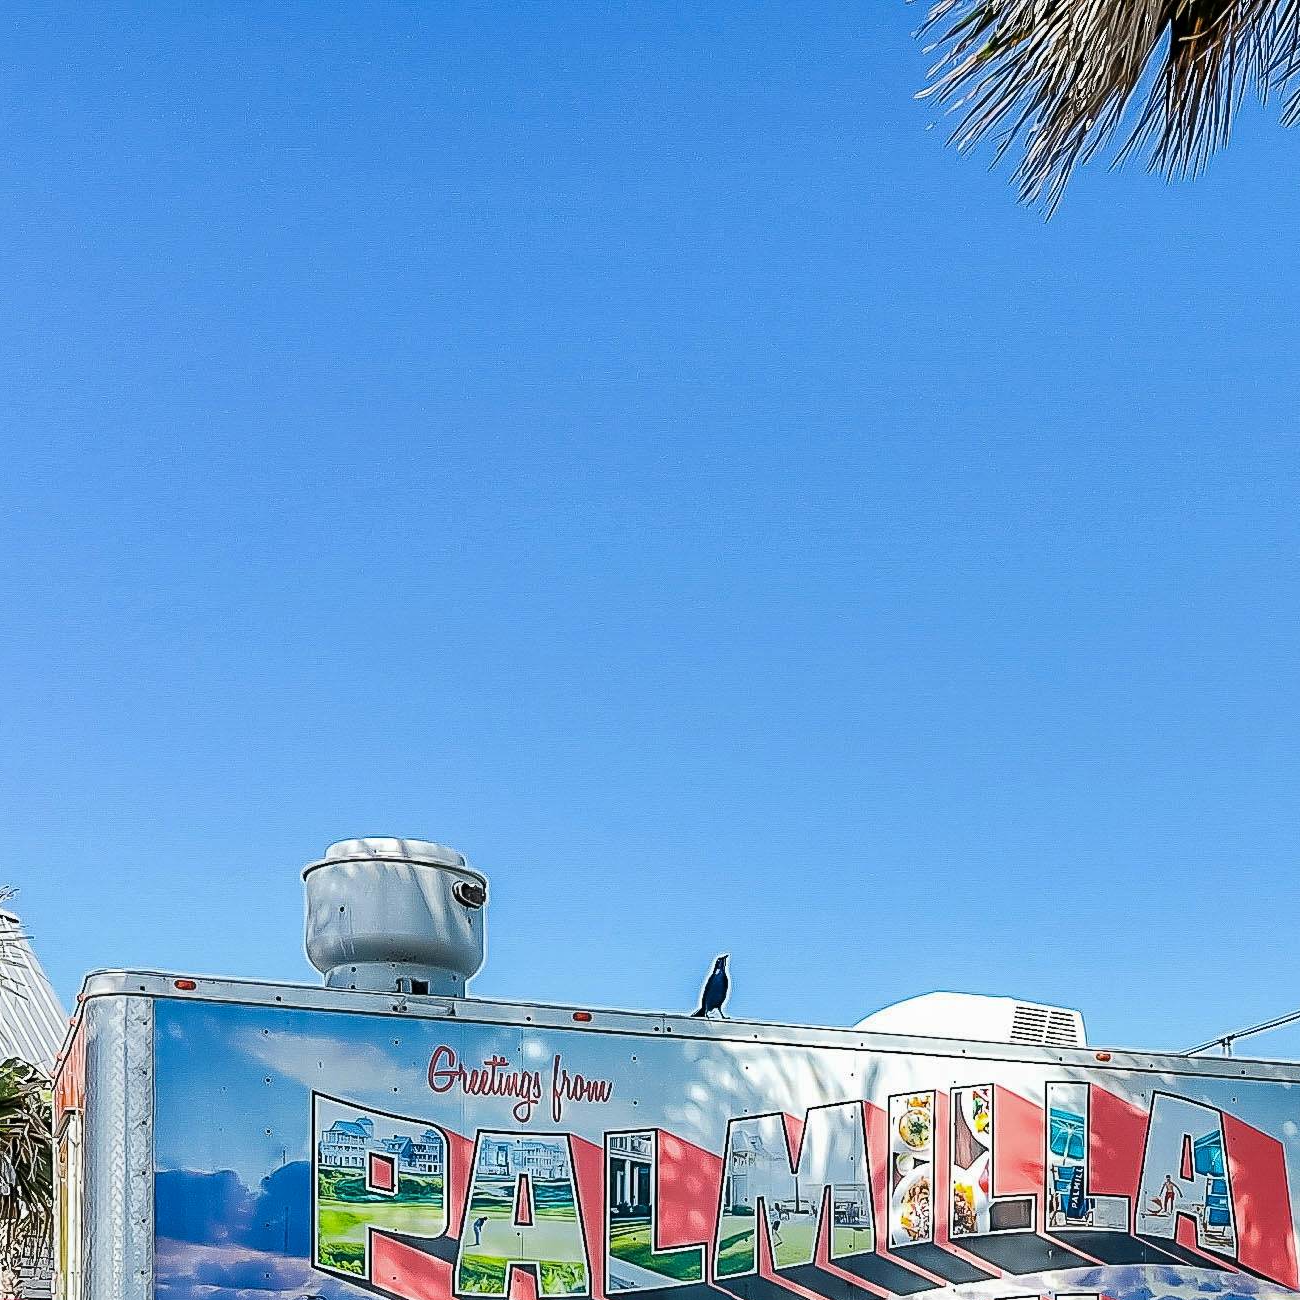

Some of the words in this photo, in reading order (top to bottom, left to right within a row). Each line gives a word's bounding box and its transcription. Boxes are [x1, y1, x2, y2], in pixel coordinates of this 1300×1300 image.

[428, 1045, 542, 1123] Greetings
[552, 1054, 613, 1123] from
[311, 1080, 1241, 1300] PALMILLA
